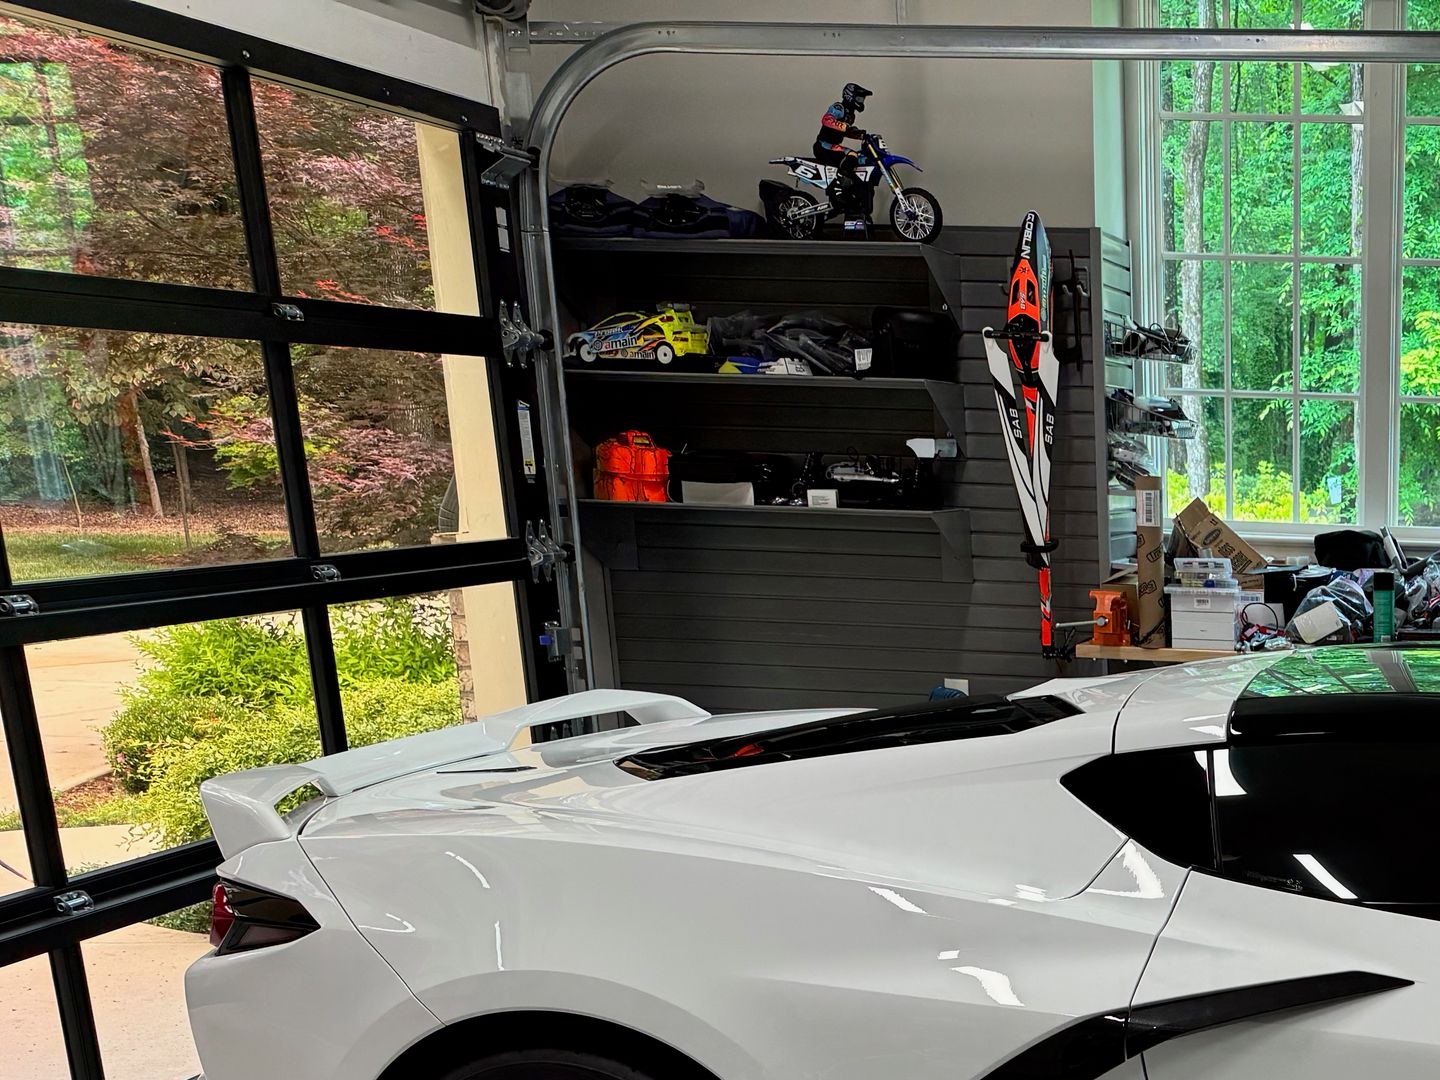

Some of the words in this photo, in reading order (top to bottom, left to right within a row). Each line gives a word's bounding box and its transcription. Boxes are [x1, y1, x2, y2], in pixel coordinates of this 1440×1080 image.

[1020, 213, 1035, 259] GOBLIN
[604, 335, 638, 350] amain
[1010, 407, 1023, 439] SAB
[1044, 413, 1055, 445] SAB
